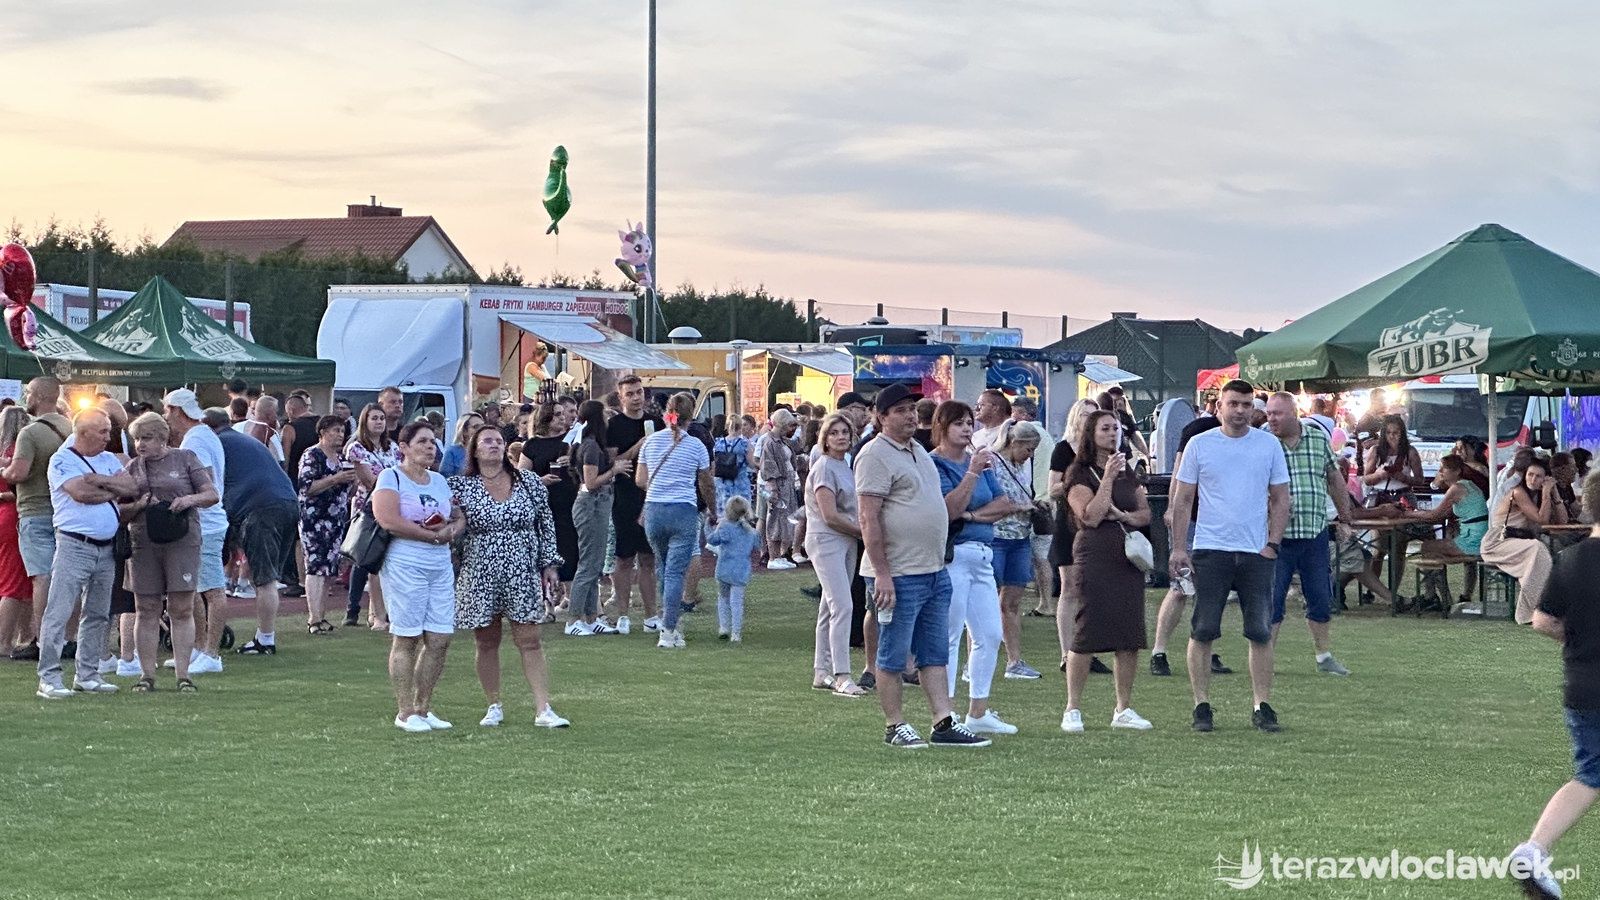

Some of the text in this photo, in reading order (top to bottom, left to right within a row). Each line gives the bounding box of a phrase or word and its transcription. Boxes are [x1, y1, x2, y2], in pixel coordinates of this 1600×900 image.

[480, 299, 500, 309] KEBAB
[503, 300, 523, 310] FRYTKI
[527, 300, 564, 311] HAMBURGER
[566, 302, 600, 313] ZAPIEKANKA
